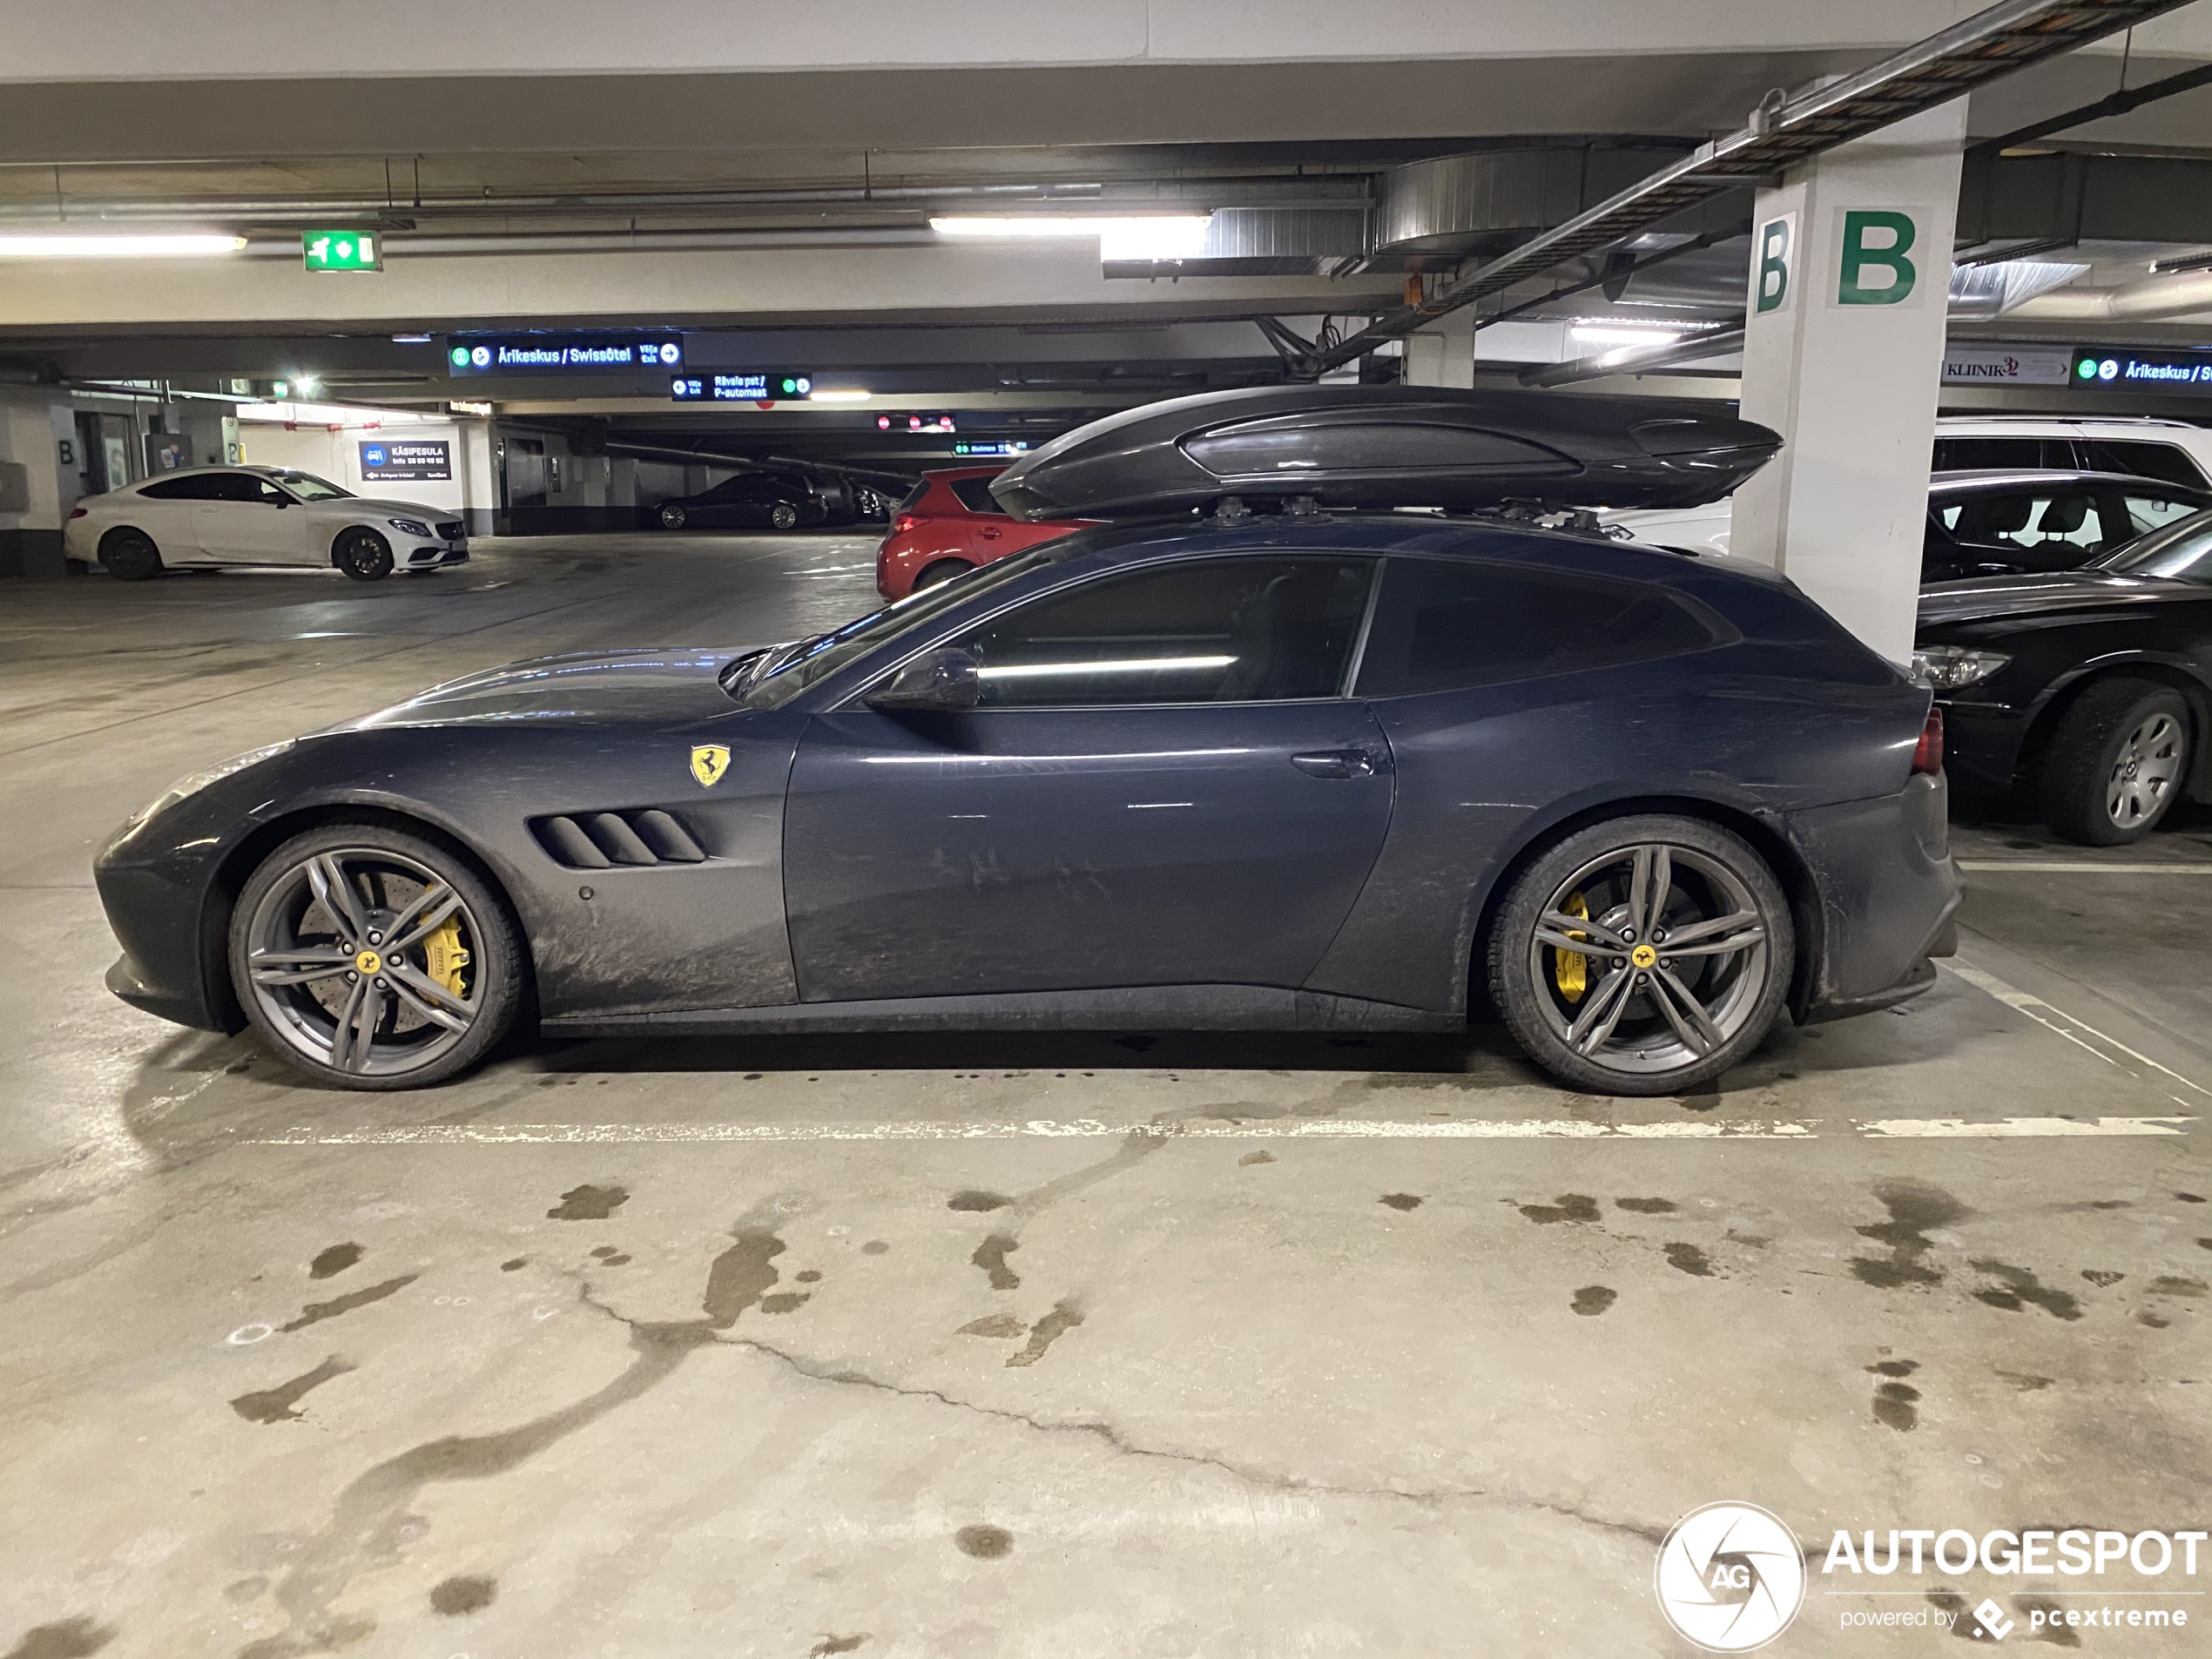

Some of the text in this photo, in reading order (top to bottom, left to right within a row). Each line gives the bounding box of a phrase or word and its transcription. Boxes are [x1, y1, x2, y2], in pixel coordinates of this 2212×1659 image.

[1757, 219, 1789, 314] B
[1838, 211, 1916, 305] B
[498, 346, 560, 363] Ärikeskus
[2126, 361, 2190, 380] Ärikeskus
[2201, 366, 2212, 381] S
[714, 388, 767, 398] P-automaat
[58, 440, 74, 464] B
[391, 445, 444, 455] KÄSIPESULA
